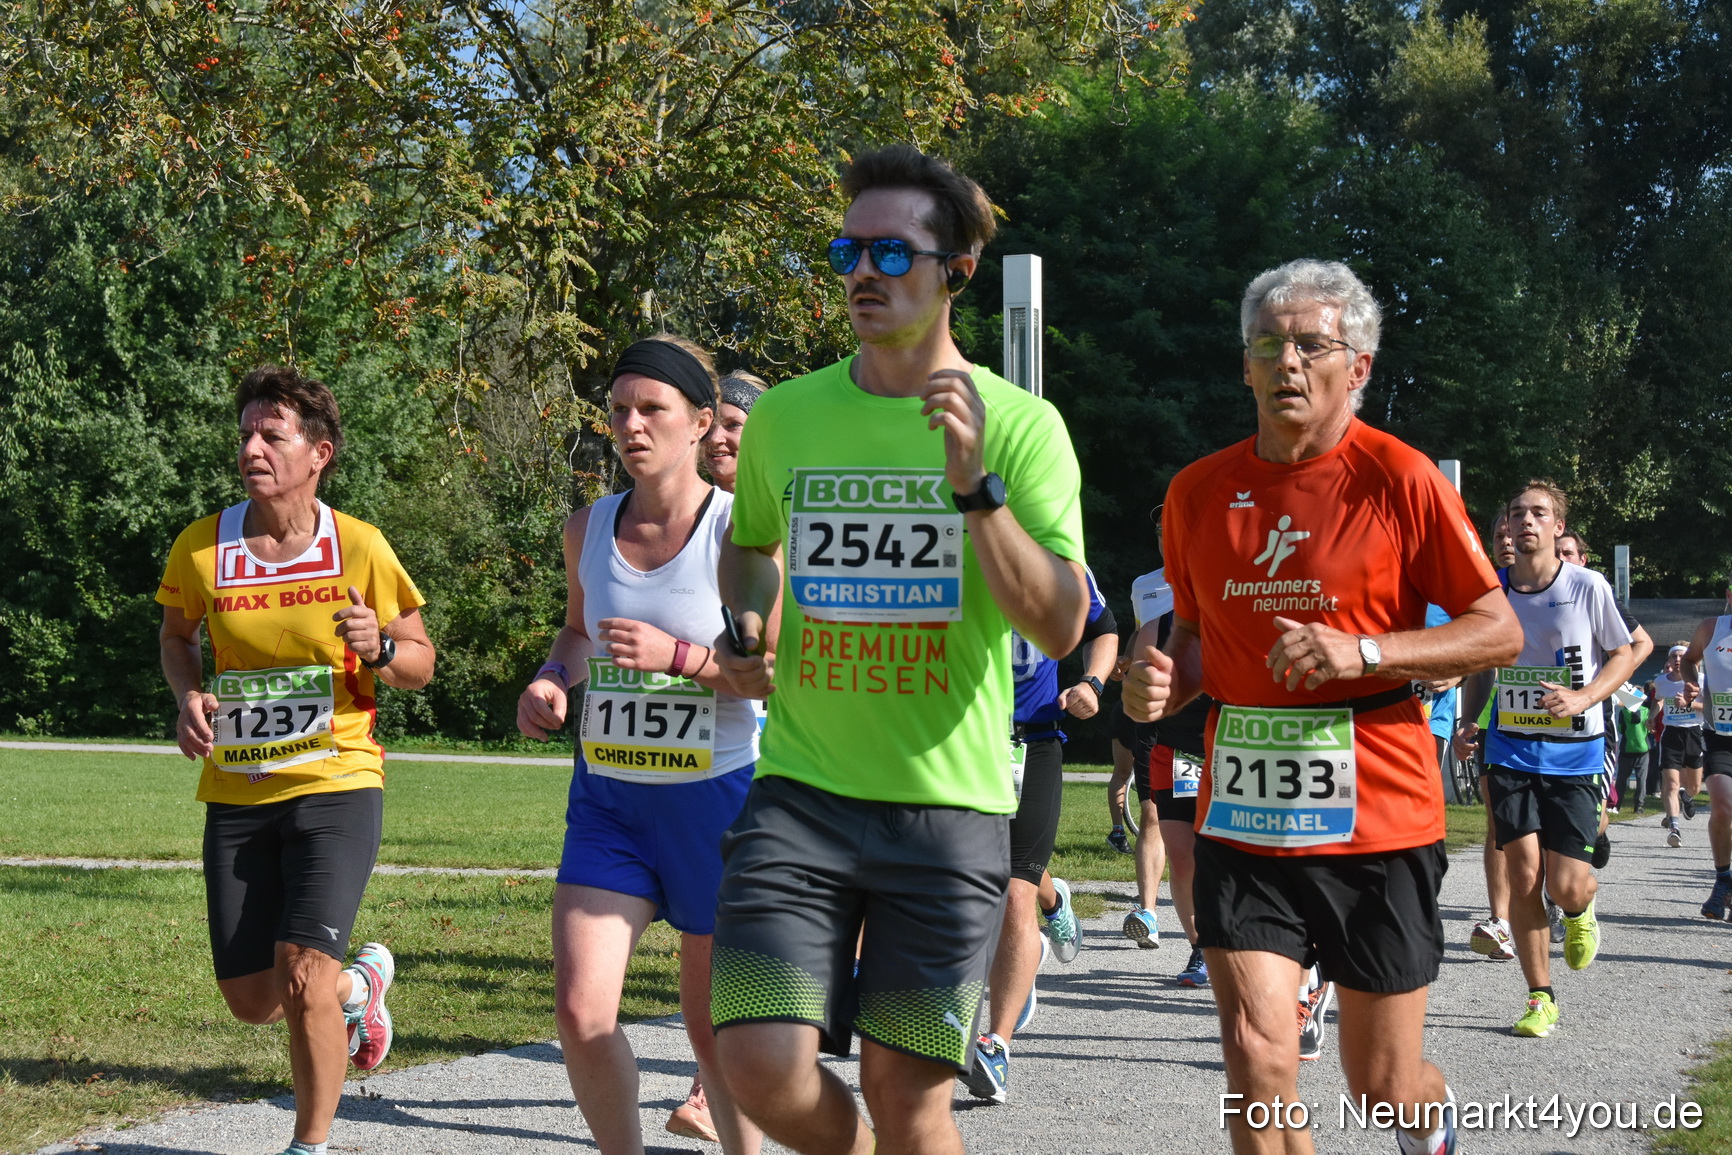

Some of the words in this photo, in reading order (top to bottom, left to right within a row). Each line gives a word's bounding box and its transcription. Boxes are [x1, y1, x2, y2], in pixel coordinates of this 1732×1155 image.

[804, 476, 944, 508] BOCK
[1229, 500, 1255, 509] erima
[807, 522, 940, 568] 2542
[213, 593, 270, 613] MAX
[279, 585, 346, 608] BÖGL
[804, 583, 943, 604] CHRISTIAN
[1222, 579, 1322, 601] funrunners
[1253, 594, 1338, 612] neumarkt
[801, 628, 947, 664] PREMIUM
[220, 671, 322, 699] BOCK
[800, 660, 949, 696] REISEN
[1503, 670, 1563, 685] BOCK
[1505, 689, 1546, 710] 113
[228, 705, 319, 739] 1237
[598, 699, 698, 740] 1157
[1225, 714, 1338, 745] BOCK
[1513, 716, 1552, 726] LUKAS
[224, 738, 322, 763] MARIANNE
[594, 747, 699, 768] CHRISTINA
[1226, 755, 1336, 800] 2133
[1230, 810, 1329, 831] MICHAEL
